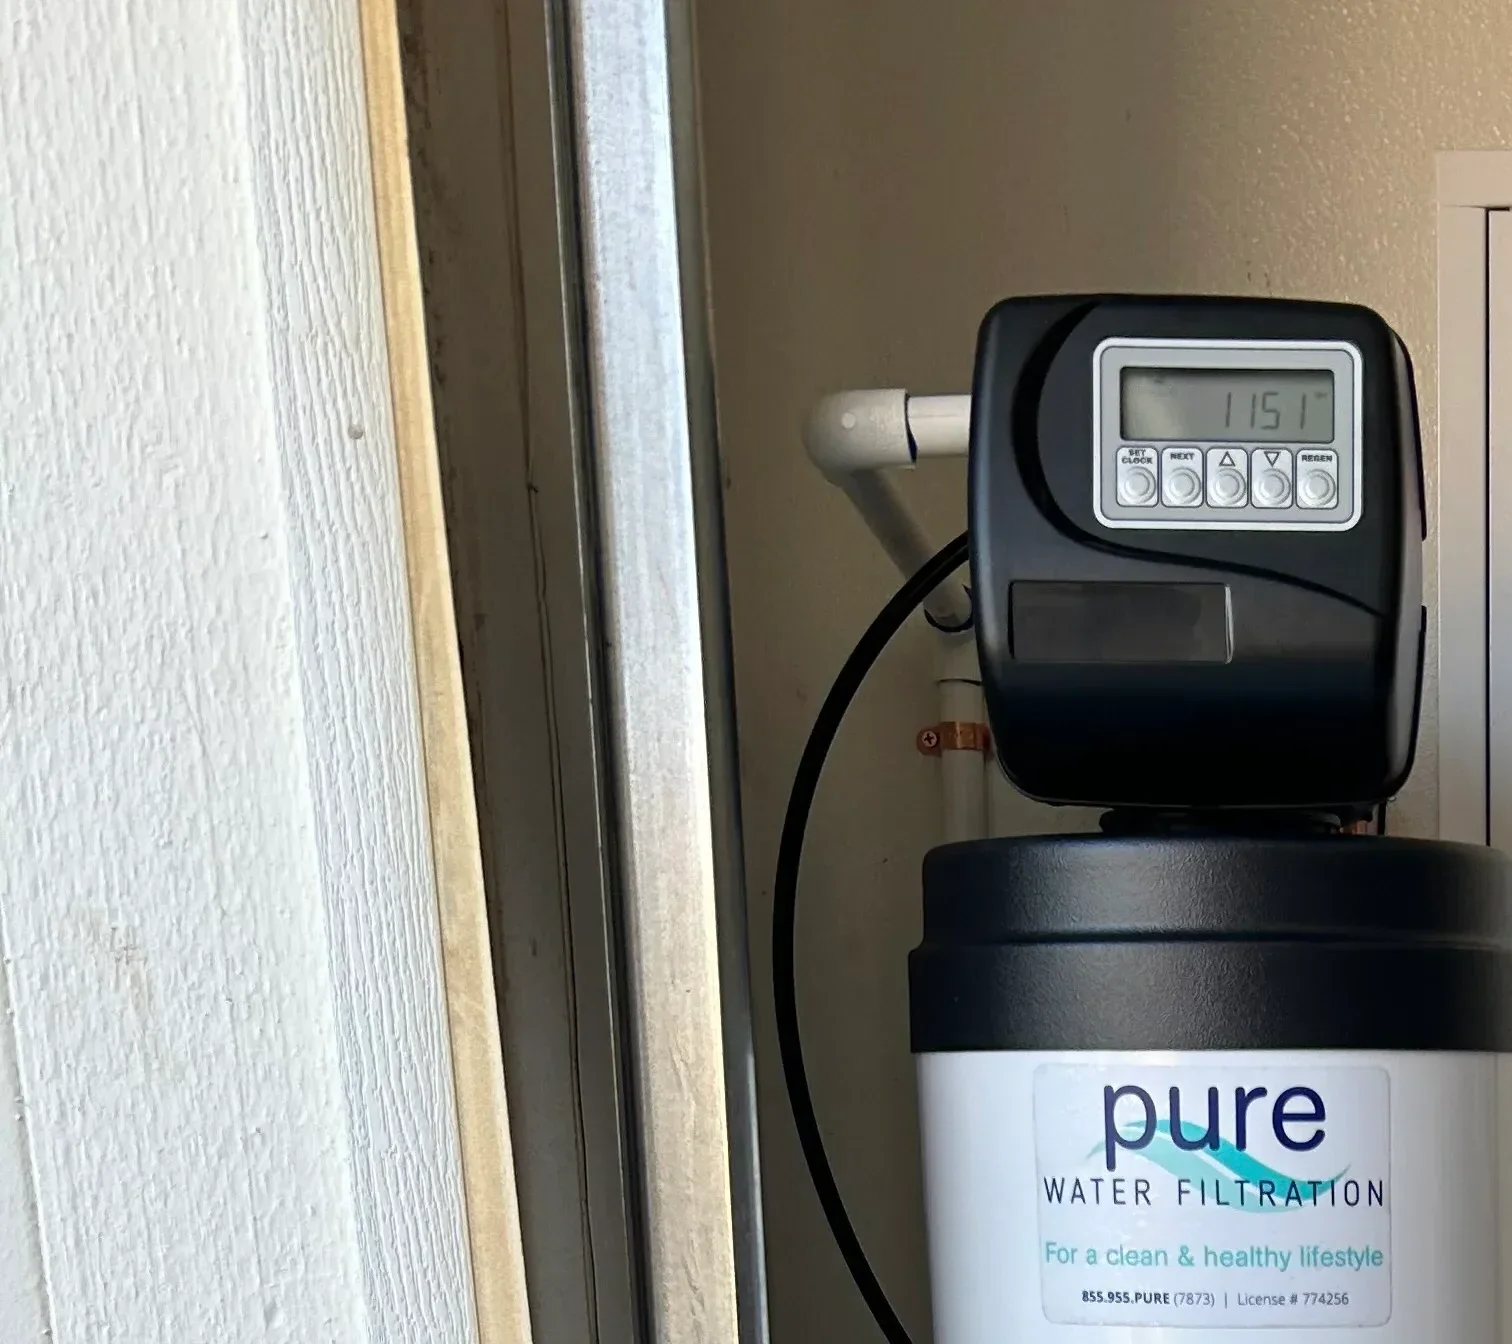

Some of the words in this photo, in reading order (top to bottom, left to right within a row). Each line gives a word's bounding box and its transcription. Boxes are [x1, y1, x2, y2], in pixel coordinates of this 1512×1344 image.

[1121, 456, 1153, 465] CLOCK
[1128, 449, 1146, 457] SET
[1169, 452, 1195, 461] NEXT
[1300, 454, 1333, 463] REGEN
[1103, 1084, 1326, 1172] pure
[1043, 1176, 1152, 1206] WATER
[1177, 1178, 1384, 1208] FILTRATION
[1045, 1241, 1078, 1265] For
[1085, 1248, 1097, 1265] a
[1106, 1244, 1168, 1267] clean
[1177, 1244, 1195, 1266] &
[1203, 1244, 1291, 1273] healthy
[1300, 1245, 1384, 1273] lifestyle
[1081, 1290, 1171, 1305] 855.955.PURE
[1173, 1291, 1215, 1308] (7873)
[1237, 1291, 1286, 1306] License
[1289, 1292, 1298, 1305] #
[1302, 1292, 1350, 1306] 774256
